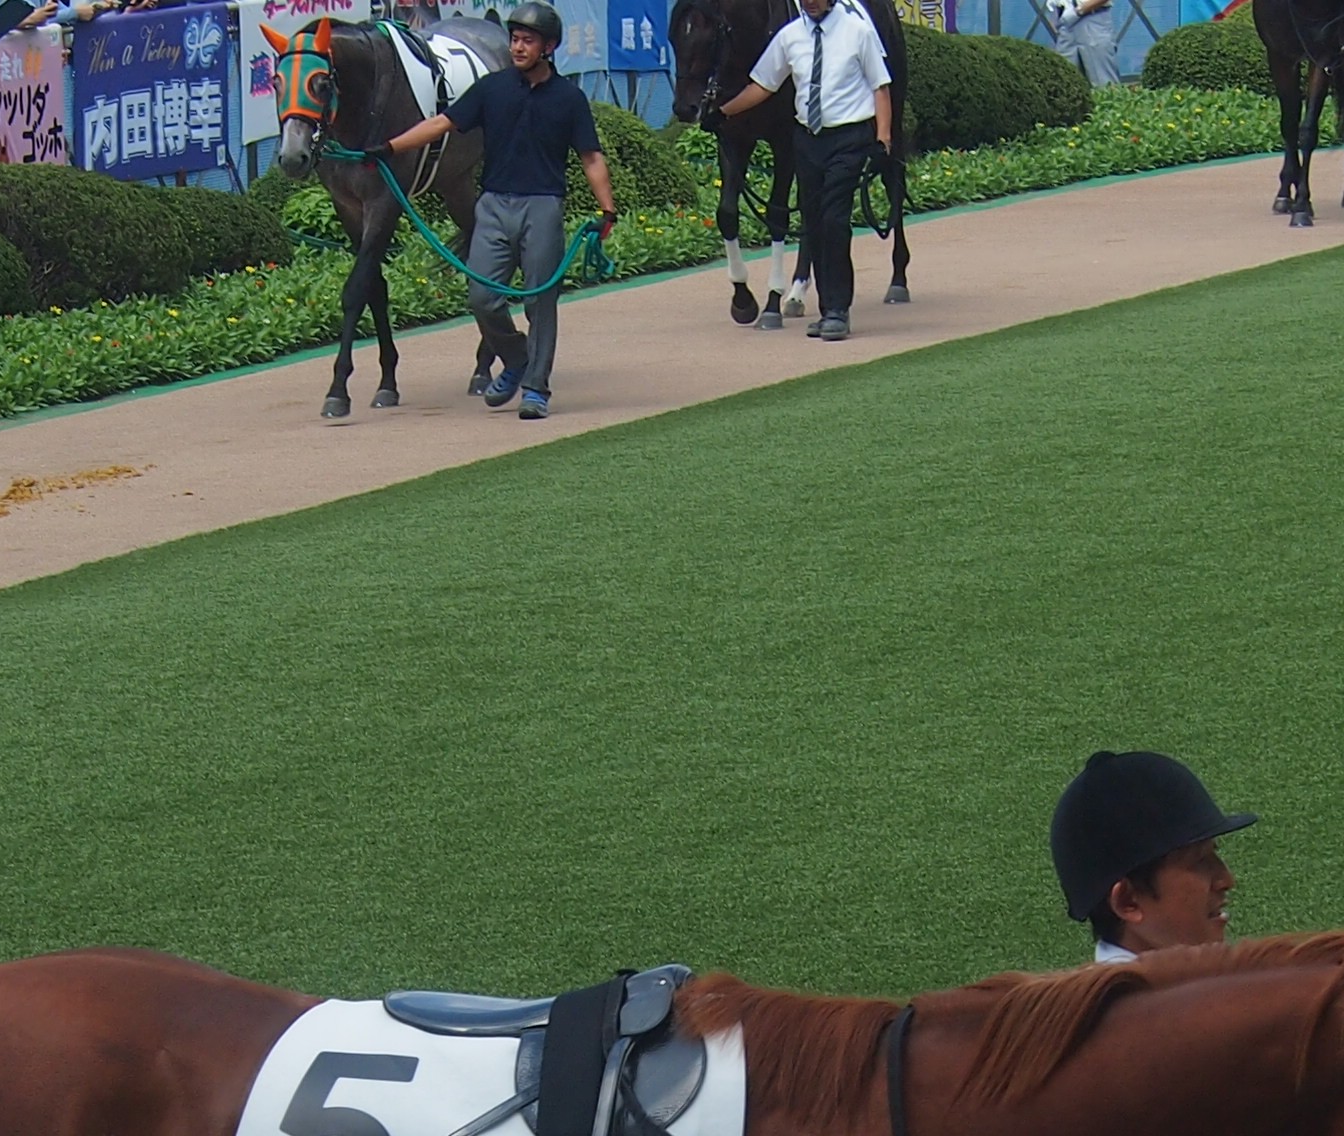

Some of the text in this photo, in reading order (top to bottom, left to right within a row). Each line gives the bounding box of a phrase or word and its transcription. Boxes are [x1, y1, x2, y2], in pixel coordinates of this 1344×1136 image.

[88, 23, 181, 75] Win a Victory
[83, 77, 223, 171] 内田博幸
